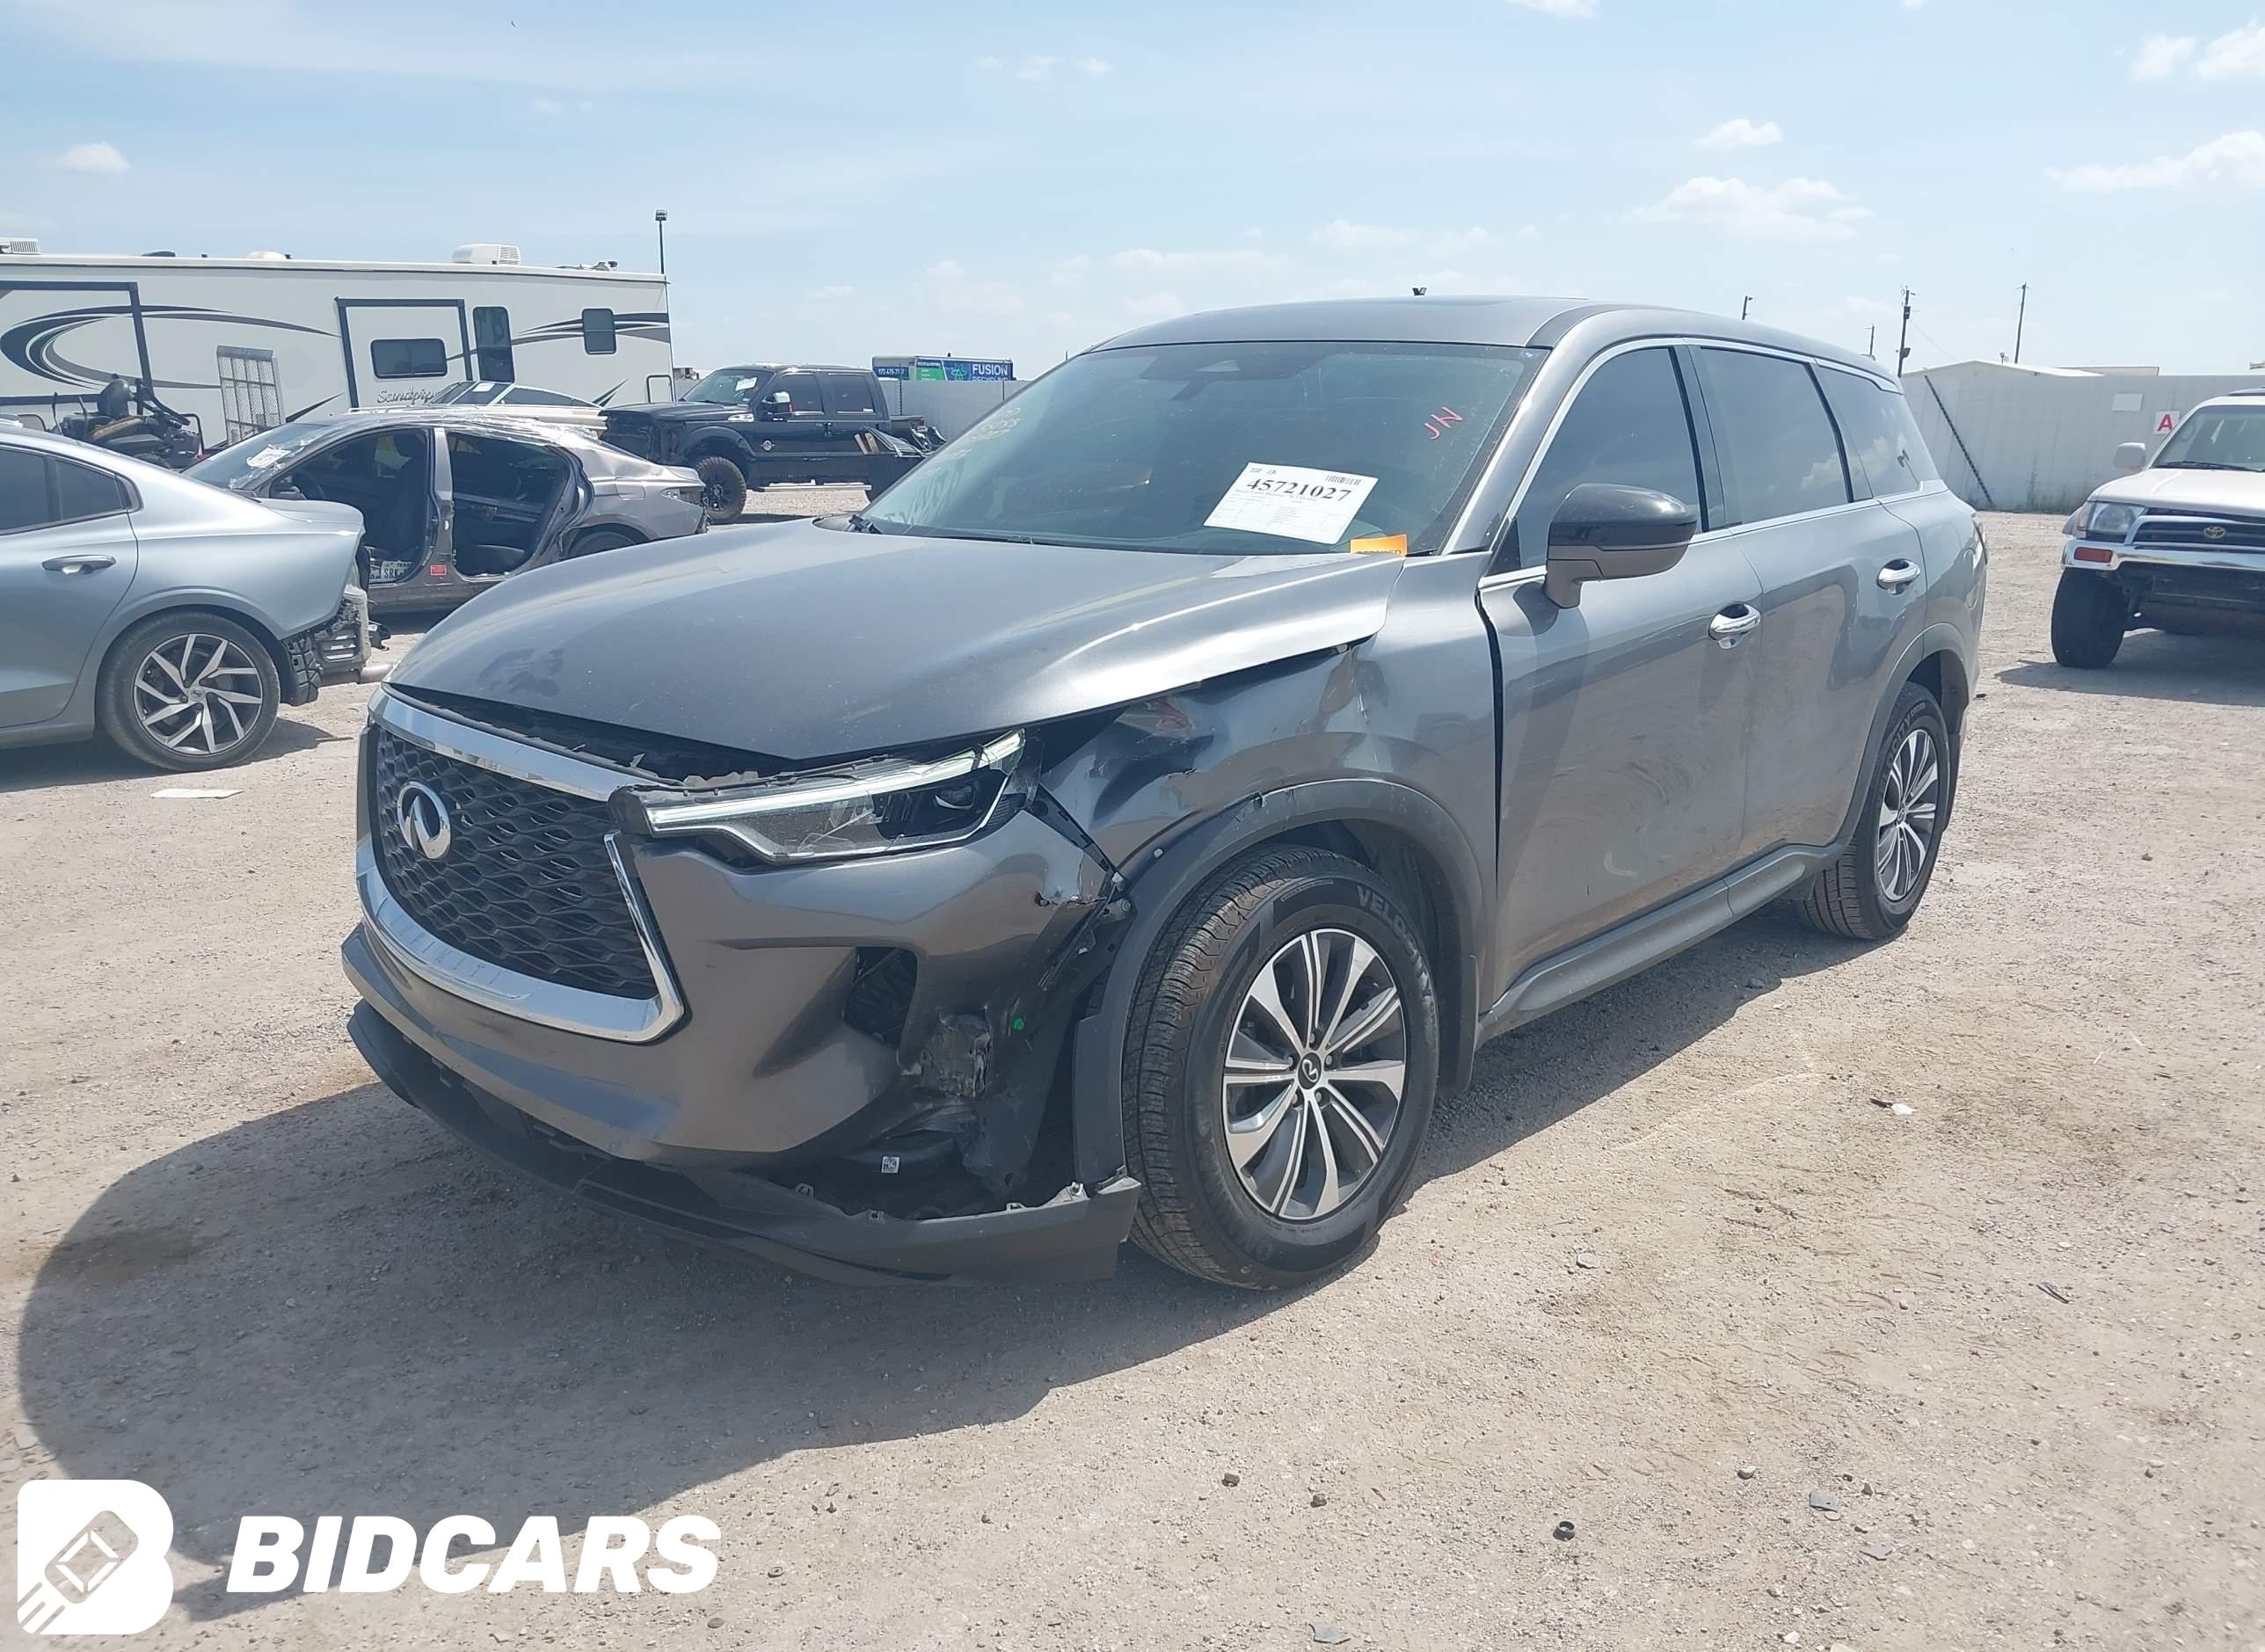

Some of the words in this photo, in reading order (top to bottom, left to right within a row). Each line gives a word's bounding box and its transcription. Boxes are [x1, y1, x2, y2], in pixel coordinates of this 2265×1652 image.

[972, 364, 1008, 375] FUSION
[376, 387, 438, 404] Sandpip
[2157, 413, 2174, 432] A
[1247, 478, 1352, 501] 45721027
